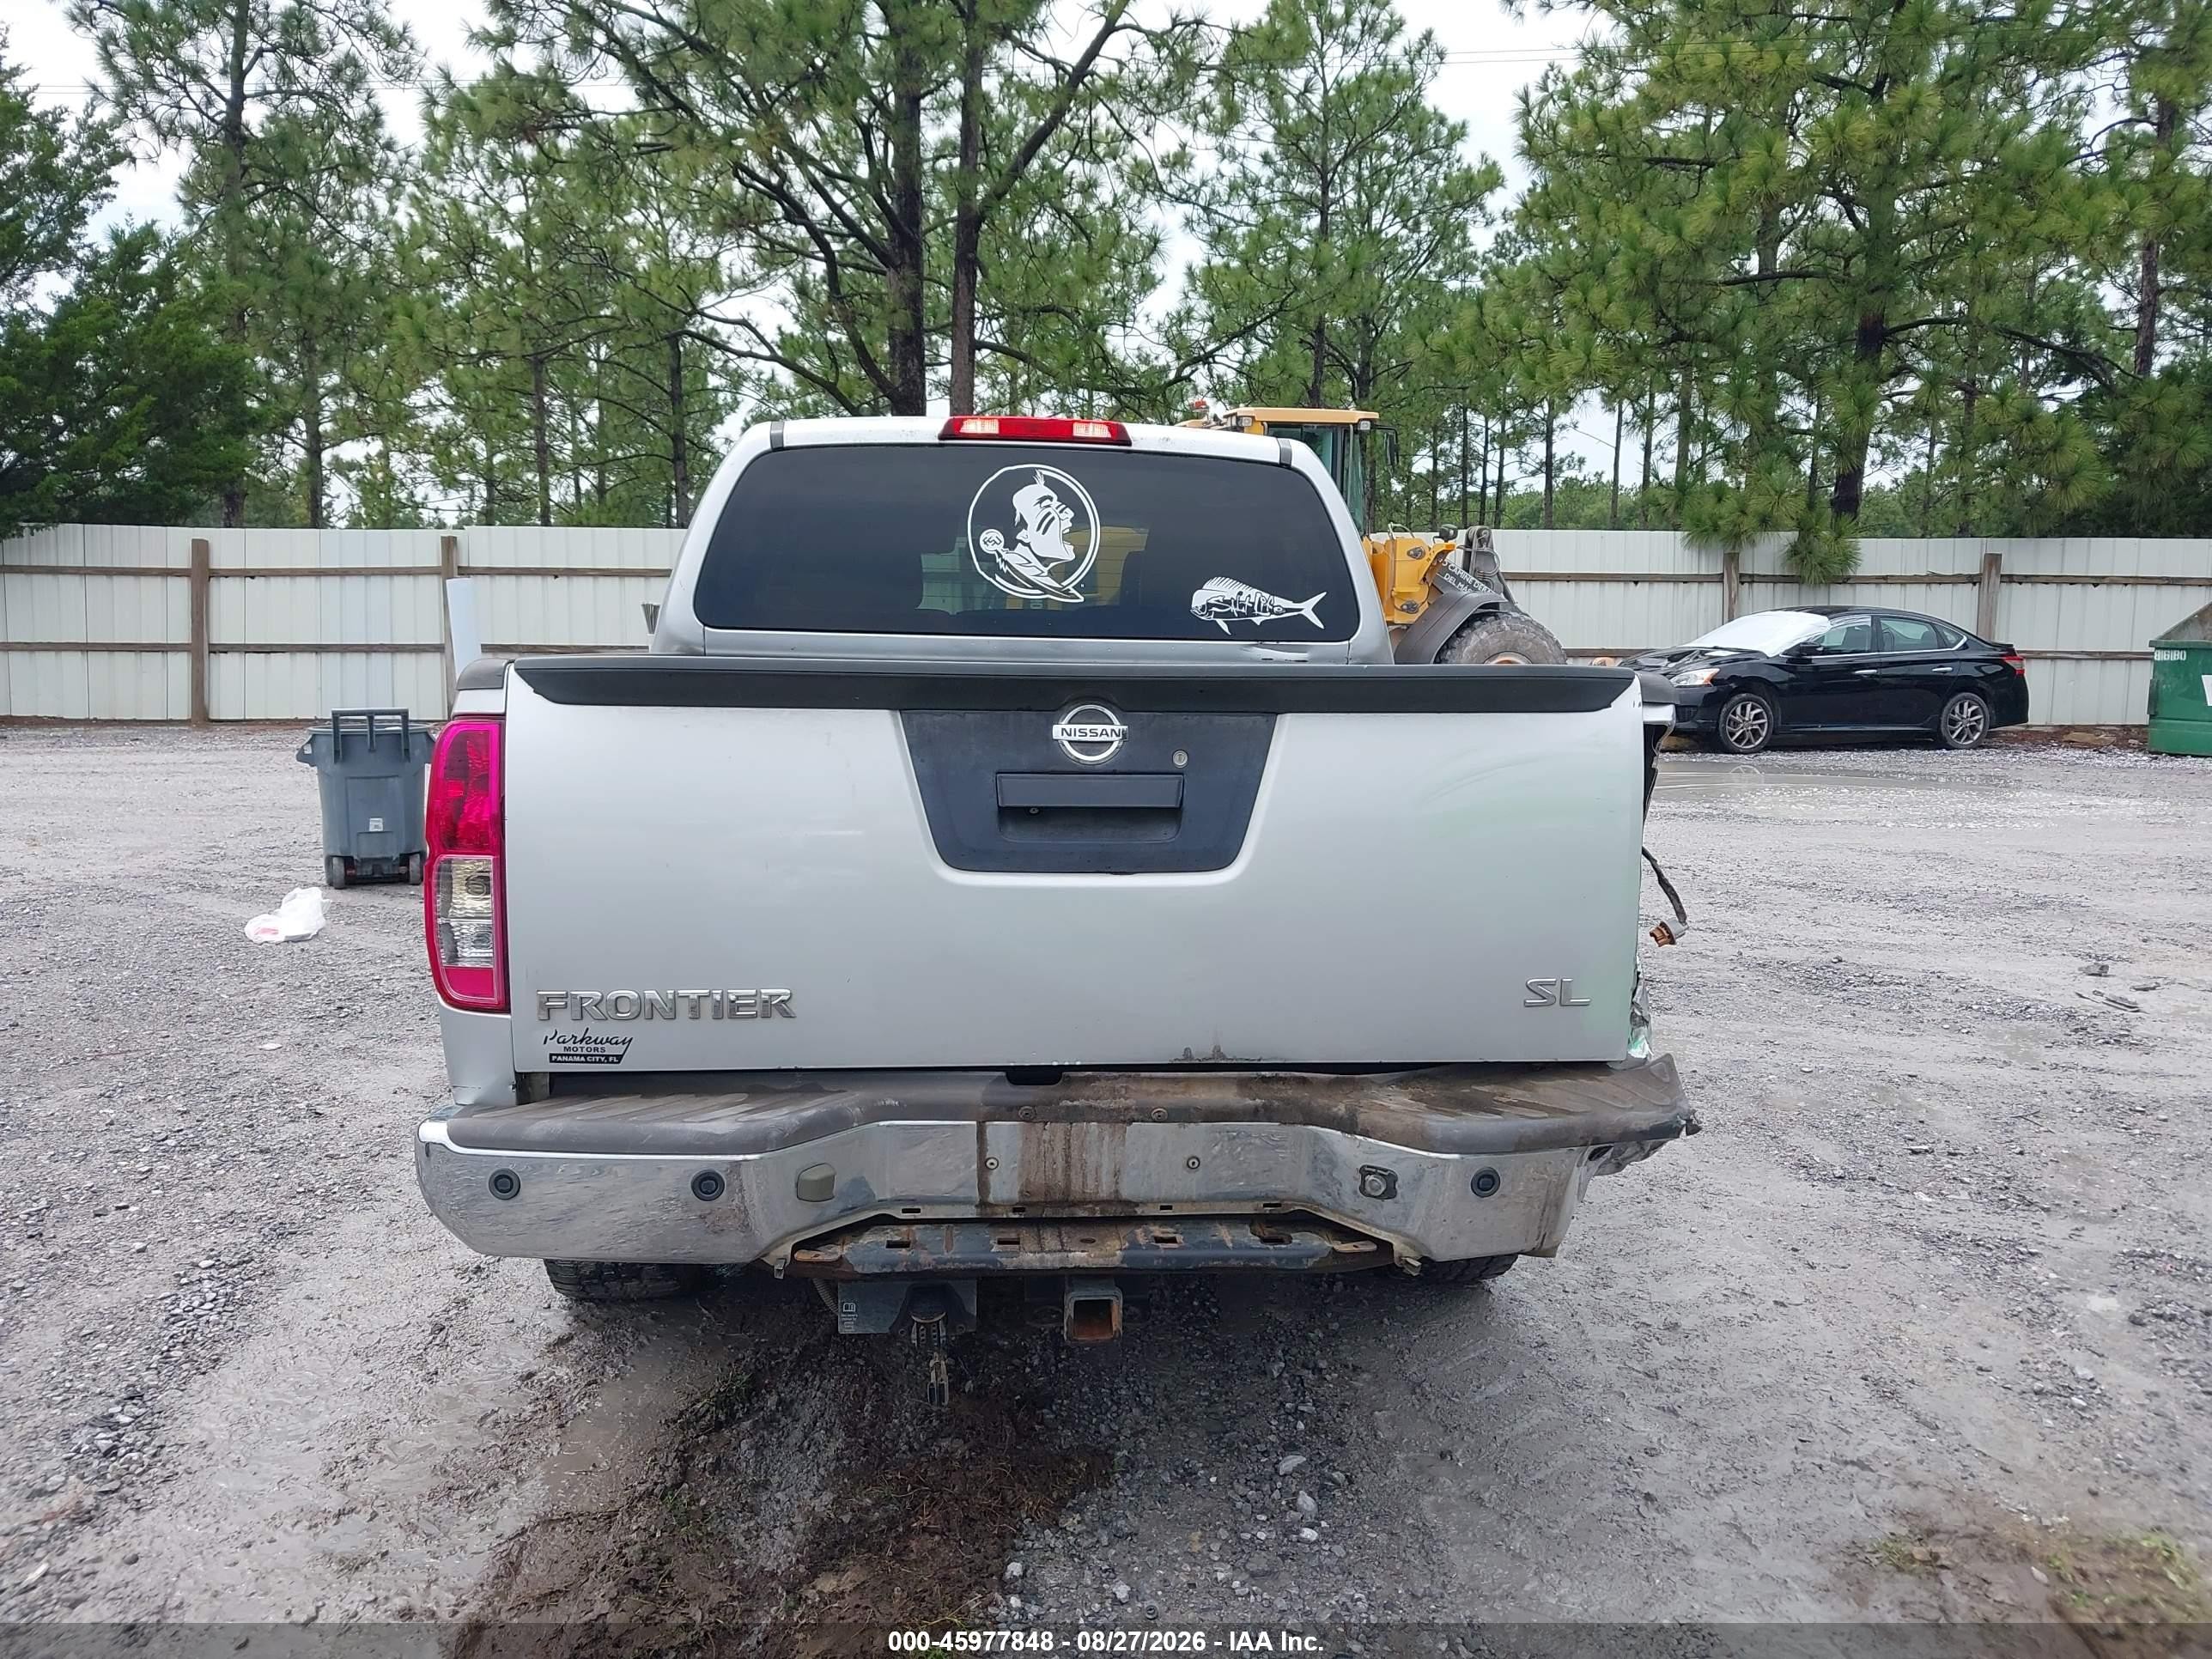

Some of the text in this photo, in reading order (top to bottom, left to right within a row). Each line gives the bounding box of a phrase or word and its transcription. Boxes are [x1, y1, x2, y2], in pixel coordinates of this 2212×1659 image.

[1443, 573, 1457, 586] DEL
[1448, 562, 1474, 585] CAMINE
[1060, 727, 1121, 738] NISSAN
[537, 988, 797, 1021] FRONTIER
[1523, 977, 1591, 1007] SL
[543, 1027, 634, 1055] Parkway
